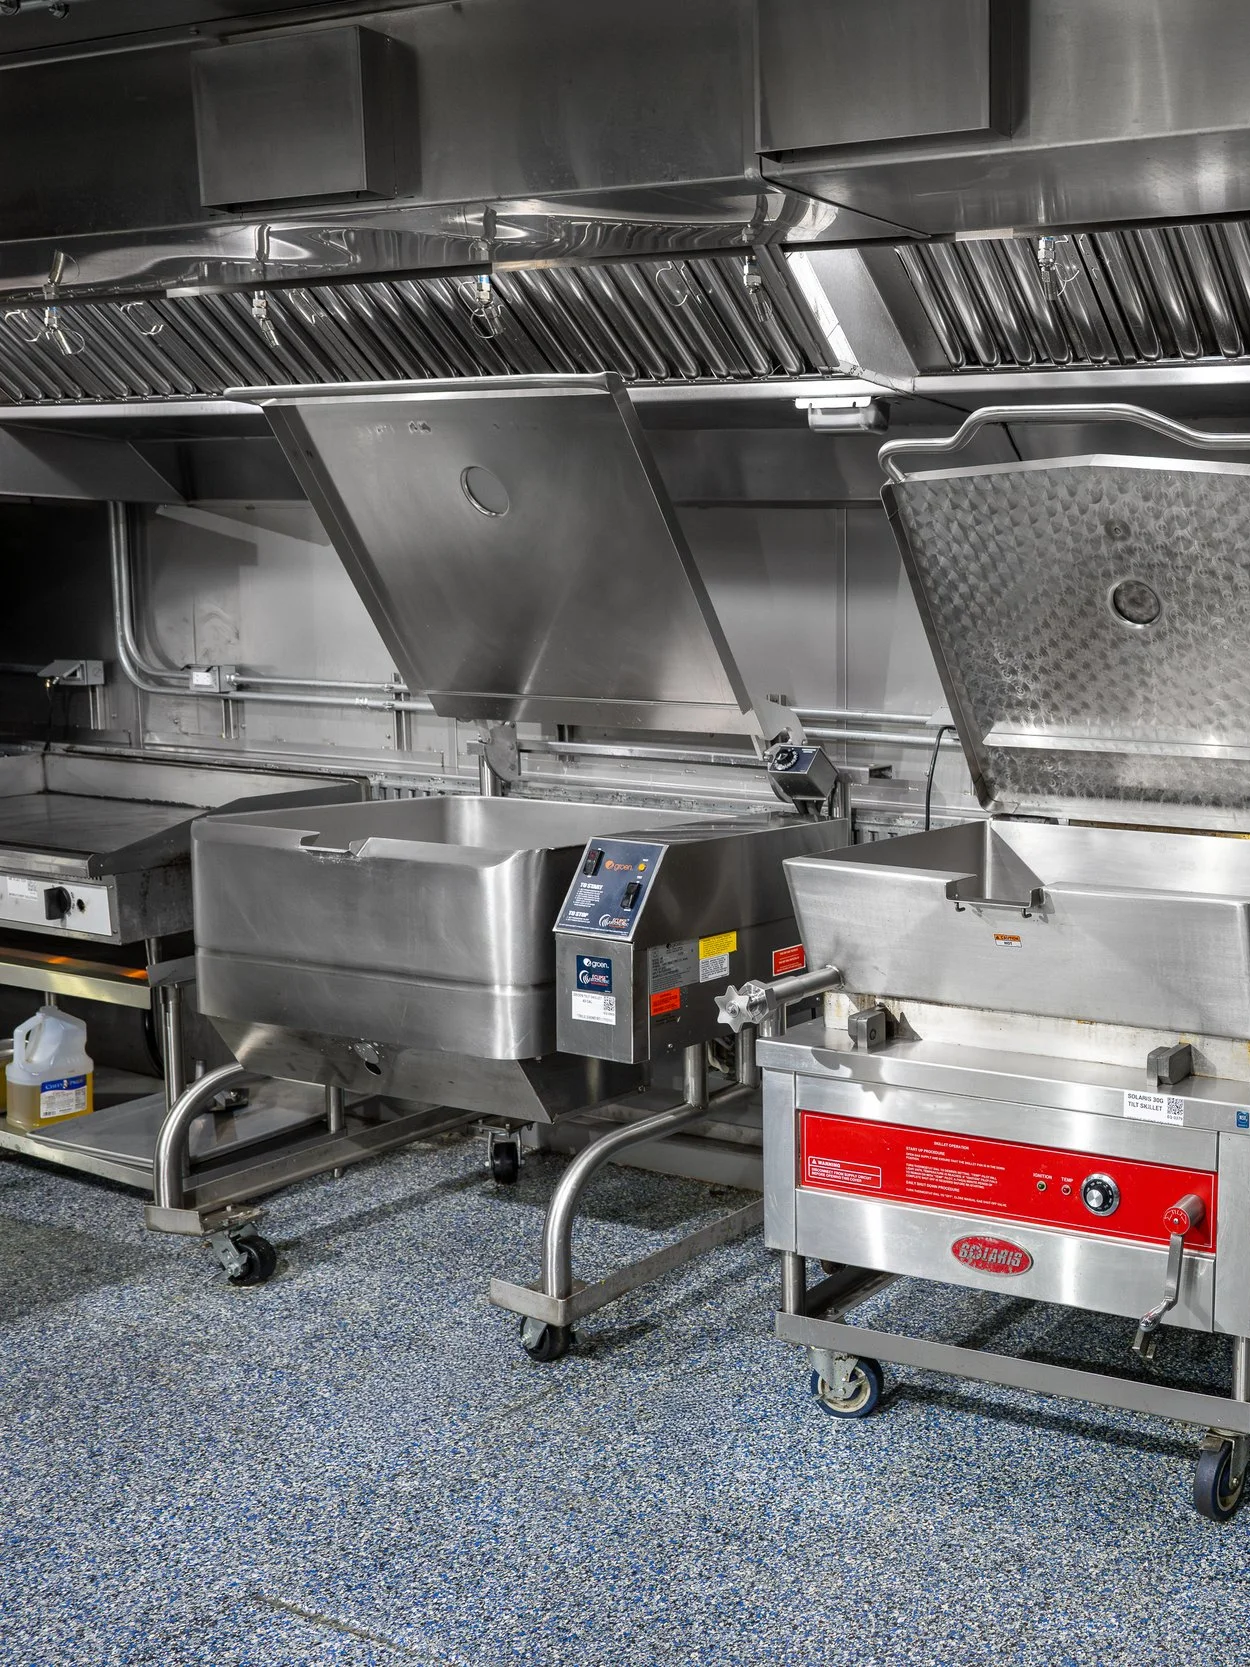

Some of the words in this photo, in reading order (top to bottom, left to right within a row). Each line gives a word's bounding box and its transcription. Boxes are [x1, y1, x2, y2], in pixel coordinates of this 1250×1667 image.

[1127, 1093, 1152, 1102] SOLARIS
[1139, 1103, 1162, 1111] SKILLET
[1032, 1172, 1053, 1180] IGNITION
[959, 1242, 1023, 1267] SOLARIS
